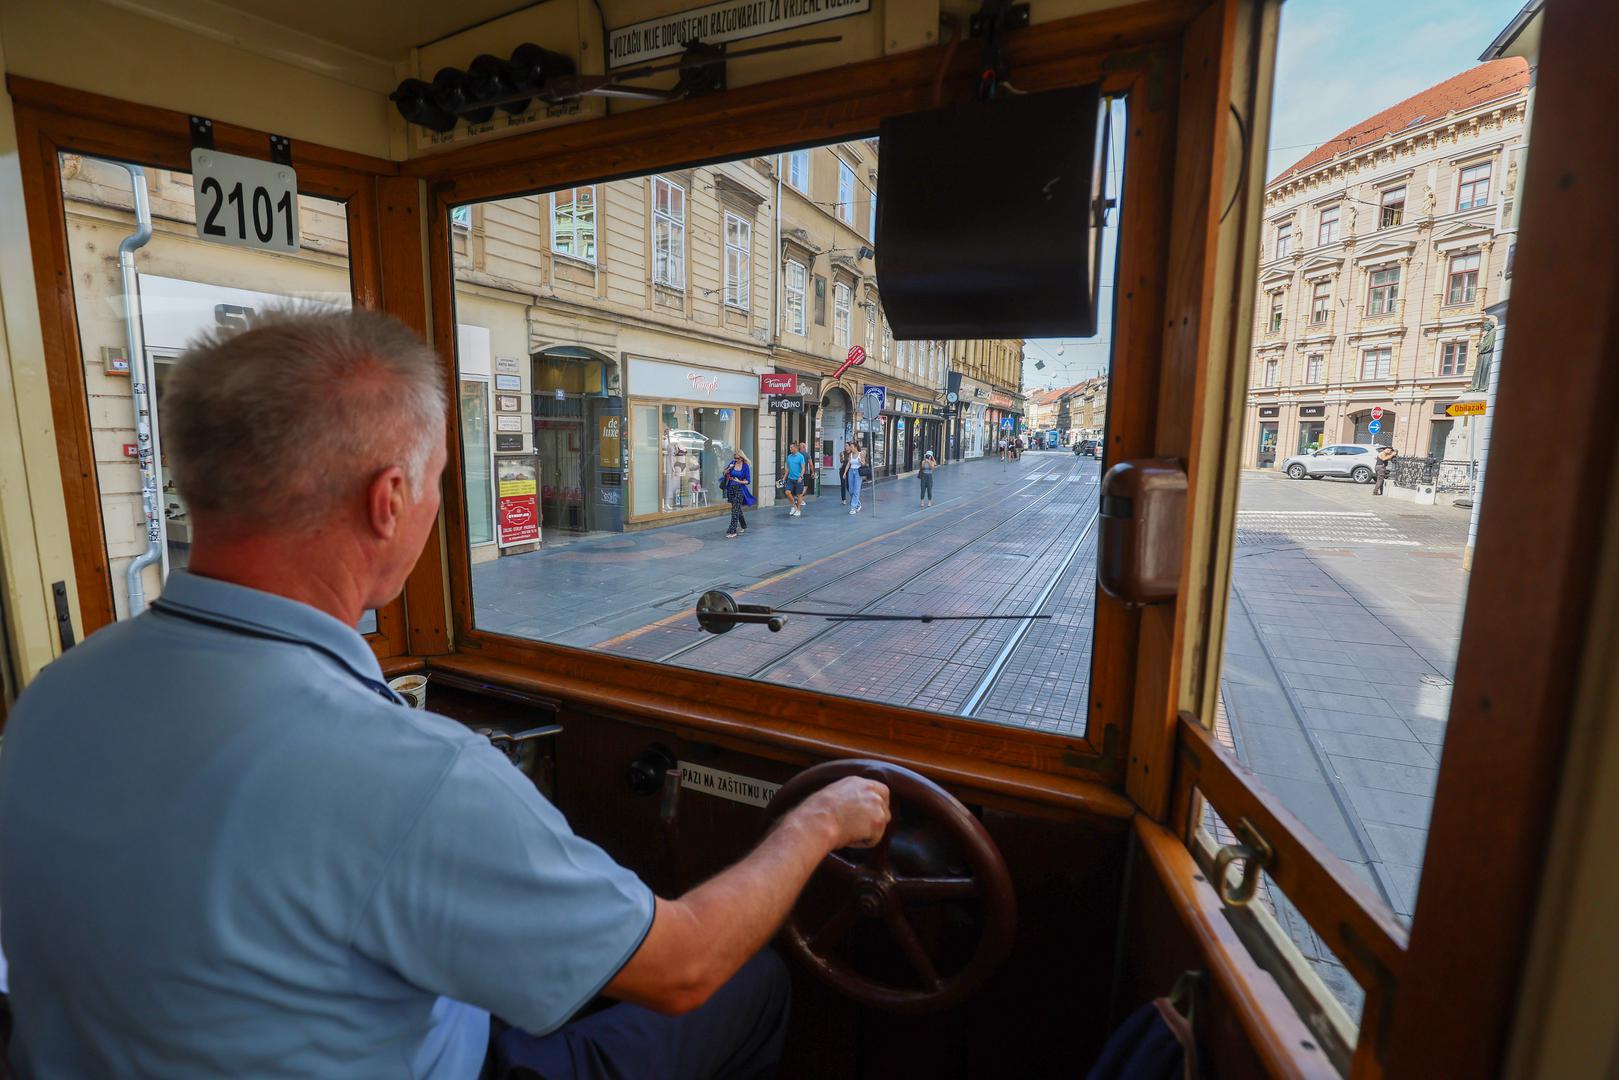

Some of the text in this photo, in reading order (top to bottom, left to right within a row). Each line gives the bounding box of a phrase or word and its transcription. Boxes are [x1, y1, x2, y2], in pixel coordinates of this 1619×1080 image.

[644, 27, 661, 52] NIJE
[711, 1, 766, 36] RAZGOVARATI
[768, 0, 781, 22] ZA
[201, 177, 294, 246] 2101
[764, 377, 792, 391] Triumph
[1455, 403, 1484, 413] Obilazak
[608, 418, 618, 428] de
[603, 426, 619, 437] luxe
[682, 768, 701, 785] PAZI
[703, 772, 715, 788] NA
[718, 776, 760, 799] ZAŠTITNU
